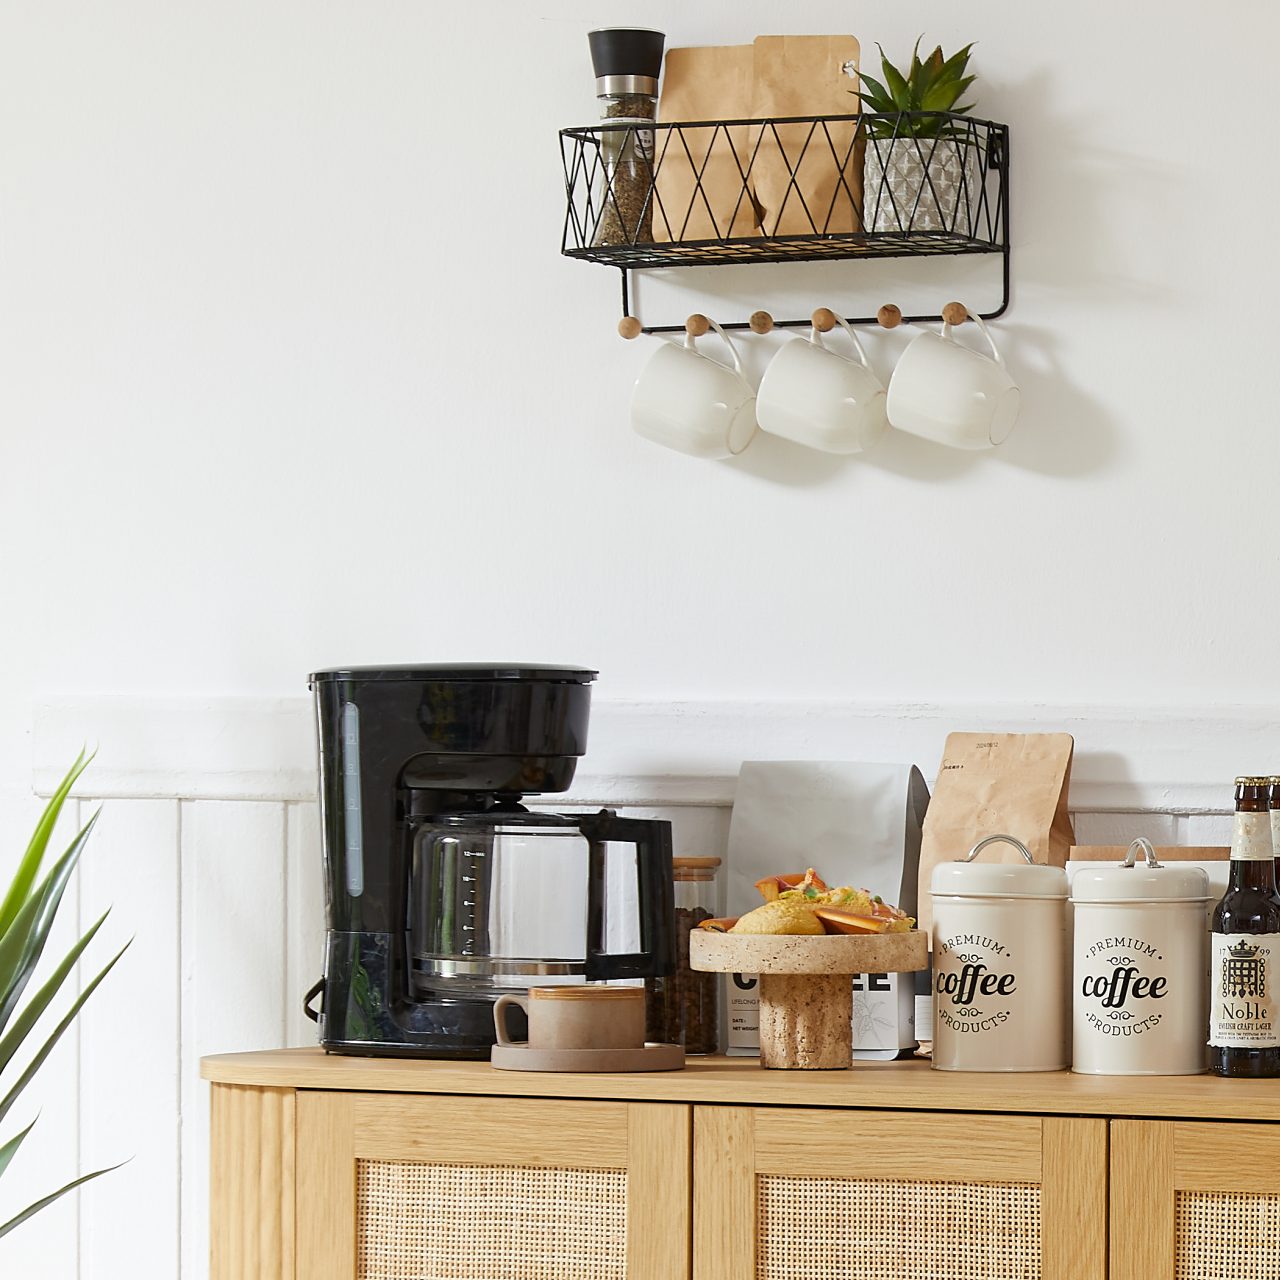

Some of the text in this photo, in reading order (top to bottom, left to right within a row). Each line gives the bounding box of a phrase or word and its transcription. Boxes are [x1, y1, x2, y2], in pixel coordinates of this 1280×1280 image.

[942, 935, 1005, 954] PREMIUM
[1090, 937, 1157, 957] PREMIUM
[937, 964, 1017, 1005] coffee
[1083, 967, 1168, 1008] coffee
[941, 1010, 1008, 1033] PRODUCTS
[1222, 1002, 1267, 1020] Noble
[1088, 1013, 1160, 1036] PRODUCTS
[1237, 1022, 1254, 1030] CRAFT
[1255, 1022, 1272, 1030] LAGER
